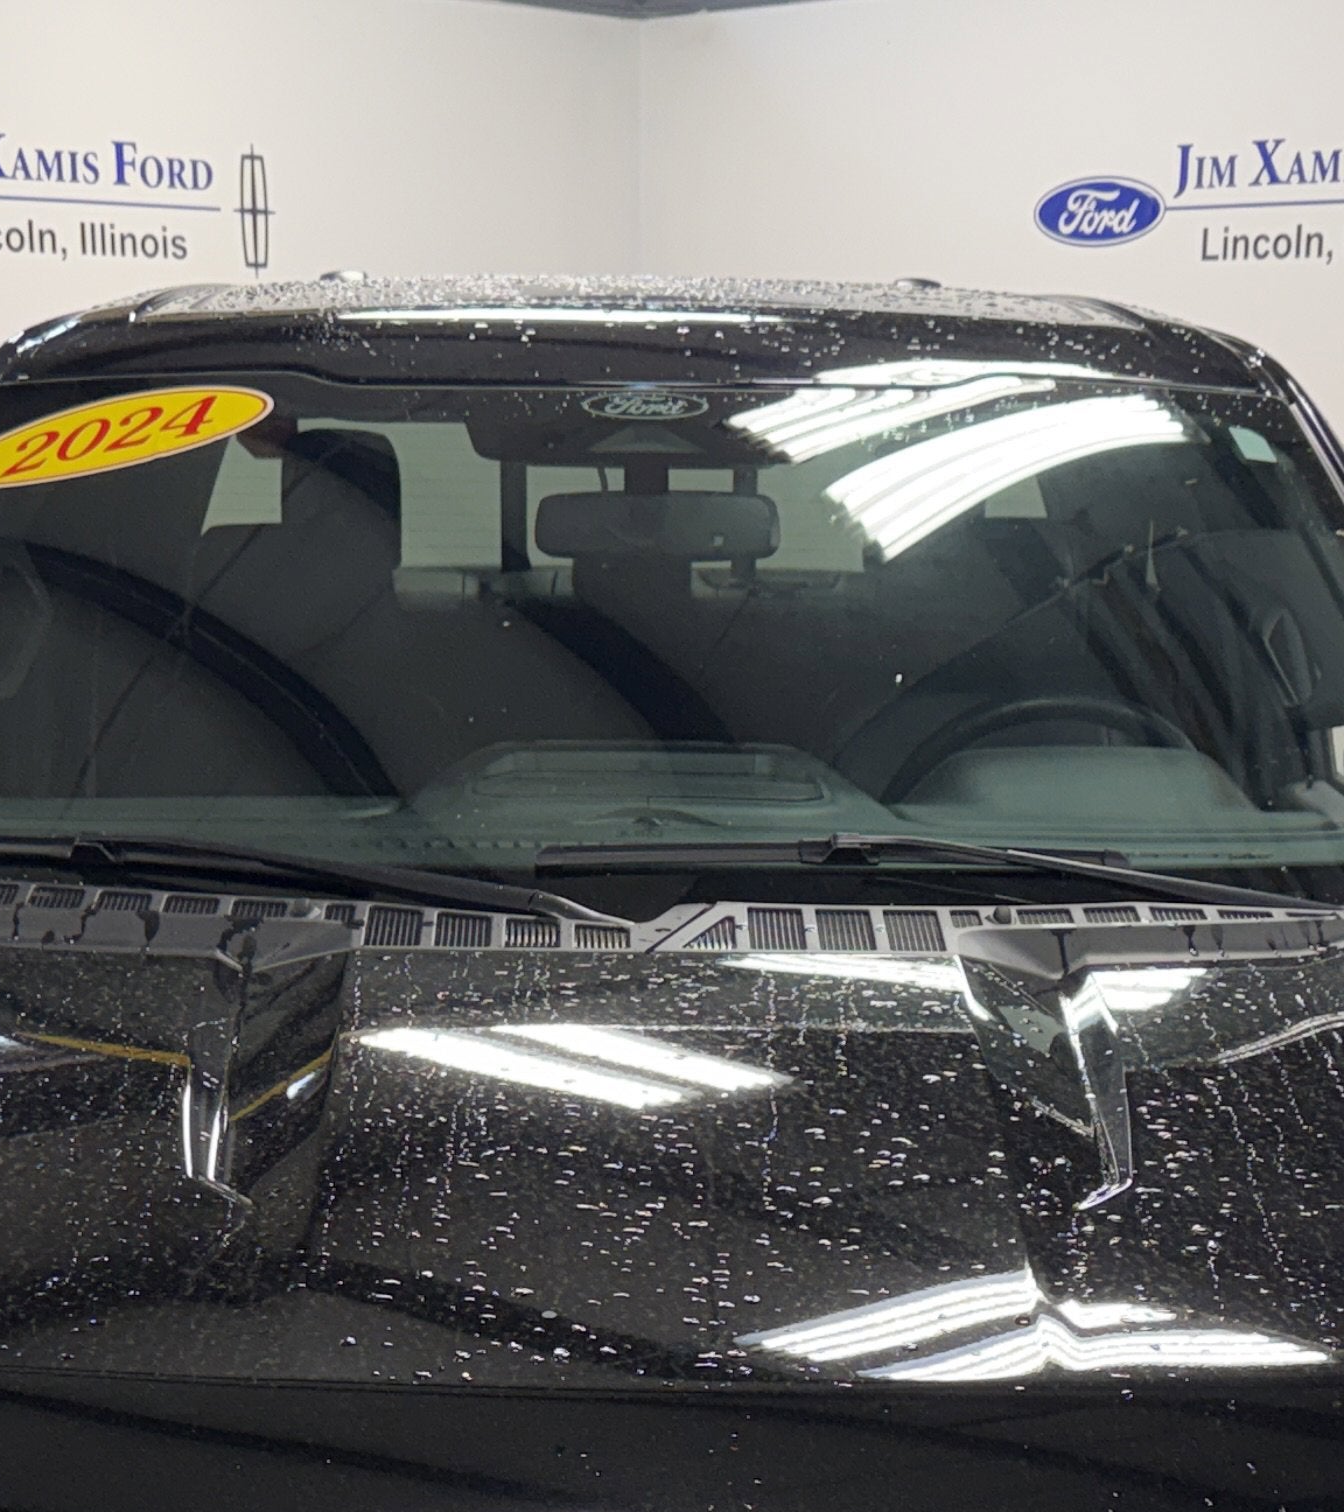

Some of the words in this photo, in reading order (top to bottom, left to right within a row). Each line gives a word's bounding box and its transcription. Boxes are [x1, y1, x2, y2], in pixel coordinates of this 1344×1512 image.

[110, 140, 214, 192] FORD
[1173, 142, 1239, 198] JIM
[1057, 188, 1138, 236] Ford
[79, 220, 189, 260] Illinois
[1199, 223, 1334, 265] Lincoln,
[604, 393, 689, 415] Ford
